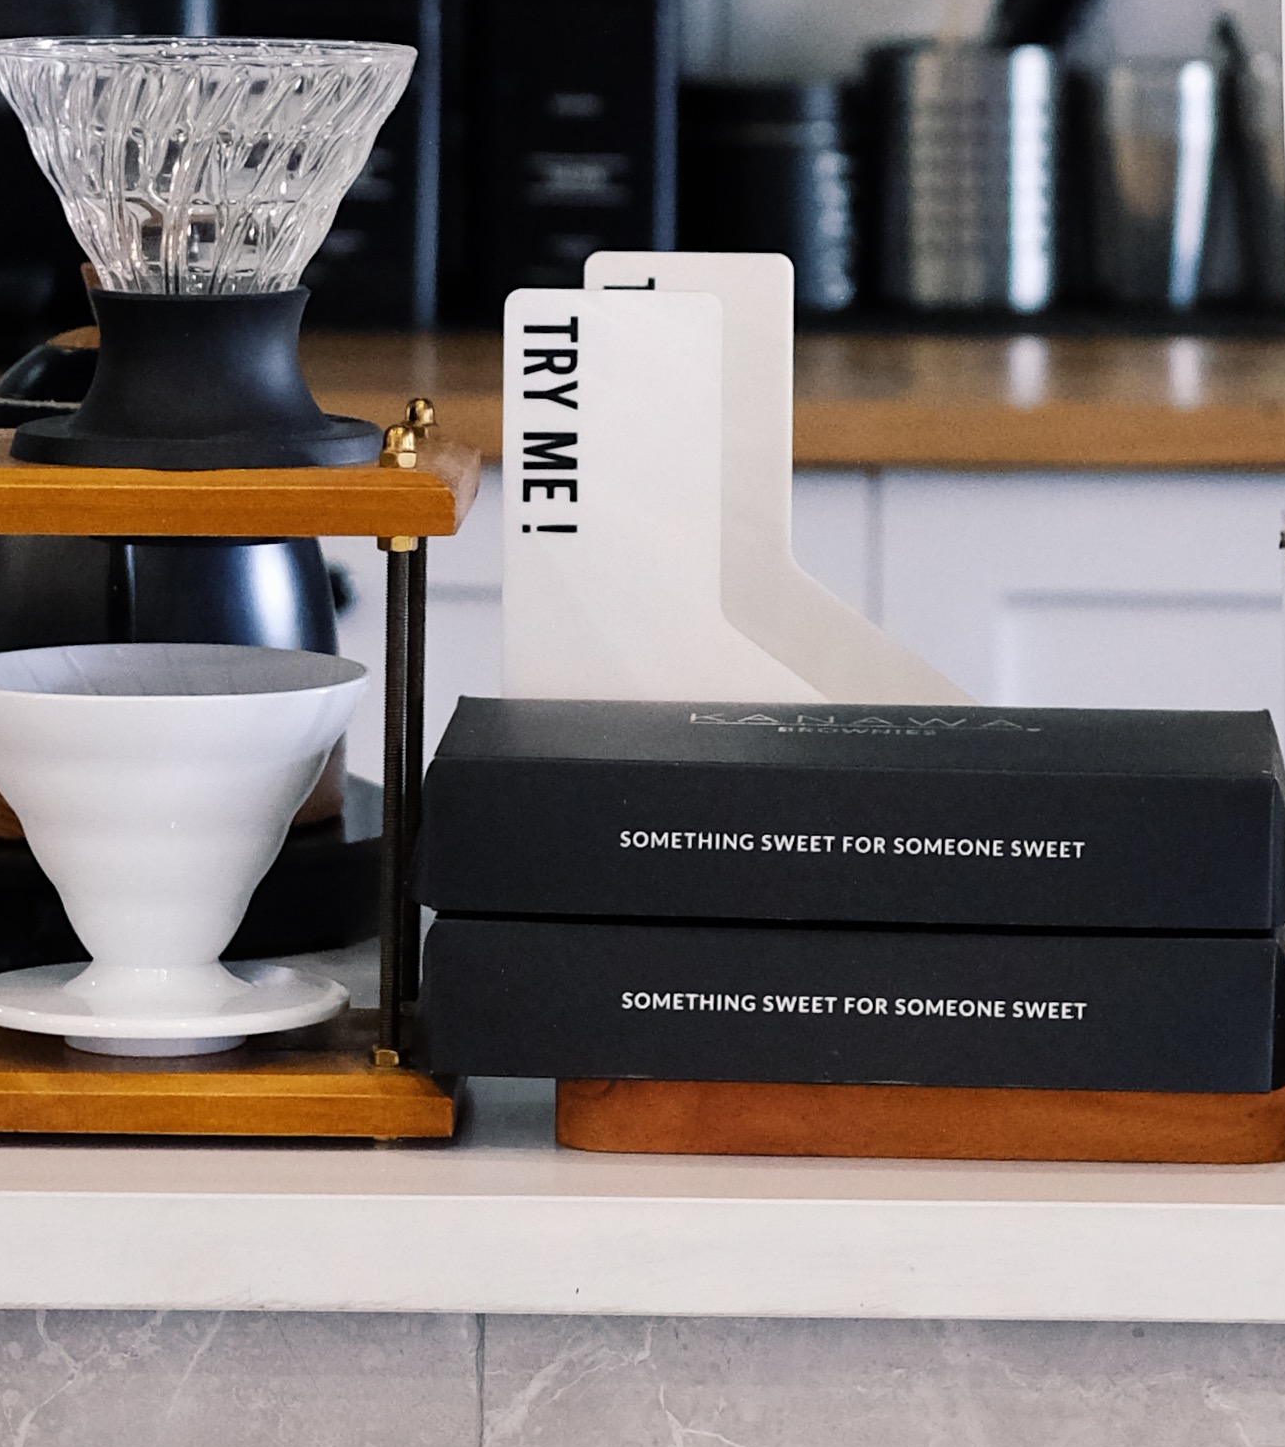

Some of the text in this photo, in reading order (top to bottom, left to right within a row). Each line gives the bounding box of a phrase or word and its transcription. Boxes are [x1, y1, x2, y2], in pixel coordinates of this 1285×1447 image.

[523, 316, 579, 410] TRY
[620, 830, 1086, 859] SOMETHING SWEET FOR SOMEONE SWEET
[621, 991, 1088, 1020] SOMETHING SWEET FOR SOMEONE SWEET
